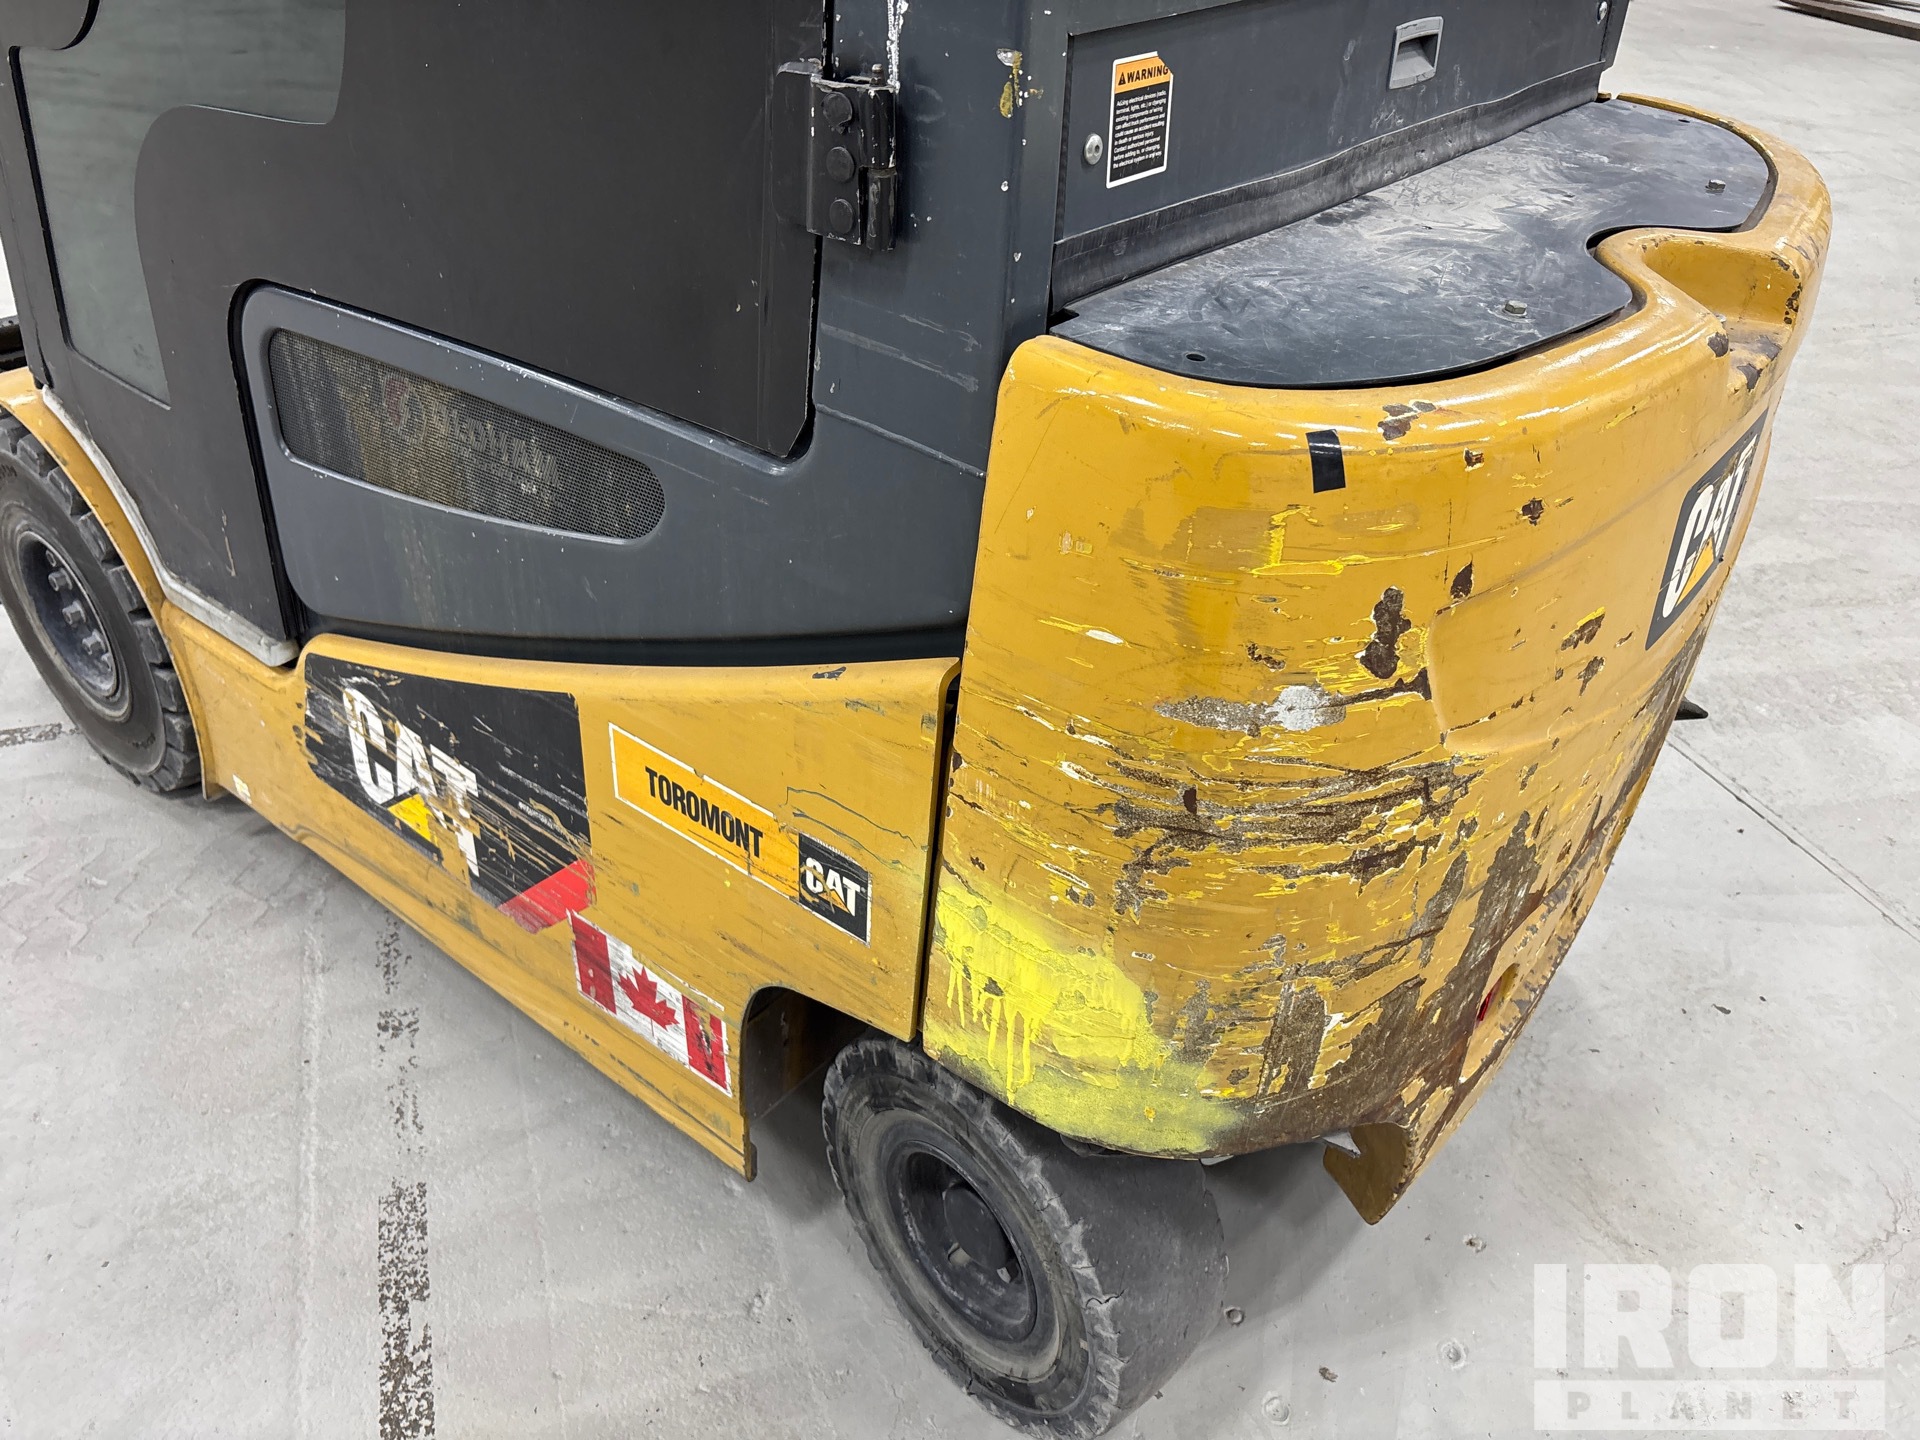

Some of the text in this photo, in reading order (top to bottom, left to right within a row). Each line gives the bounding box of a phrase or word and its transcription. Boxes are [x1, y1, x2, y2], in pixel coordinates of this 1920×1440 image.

[1127, 65, 1168, 83] WARNING
[1663, 434, 1757, 618] CAT
[343, 687, 479, 877] CAT
[645, 766, 764, 858] TOROMONT
[806, 857, 860, 916] CAT
